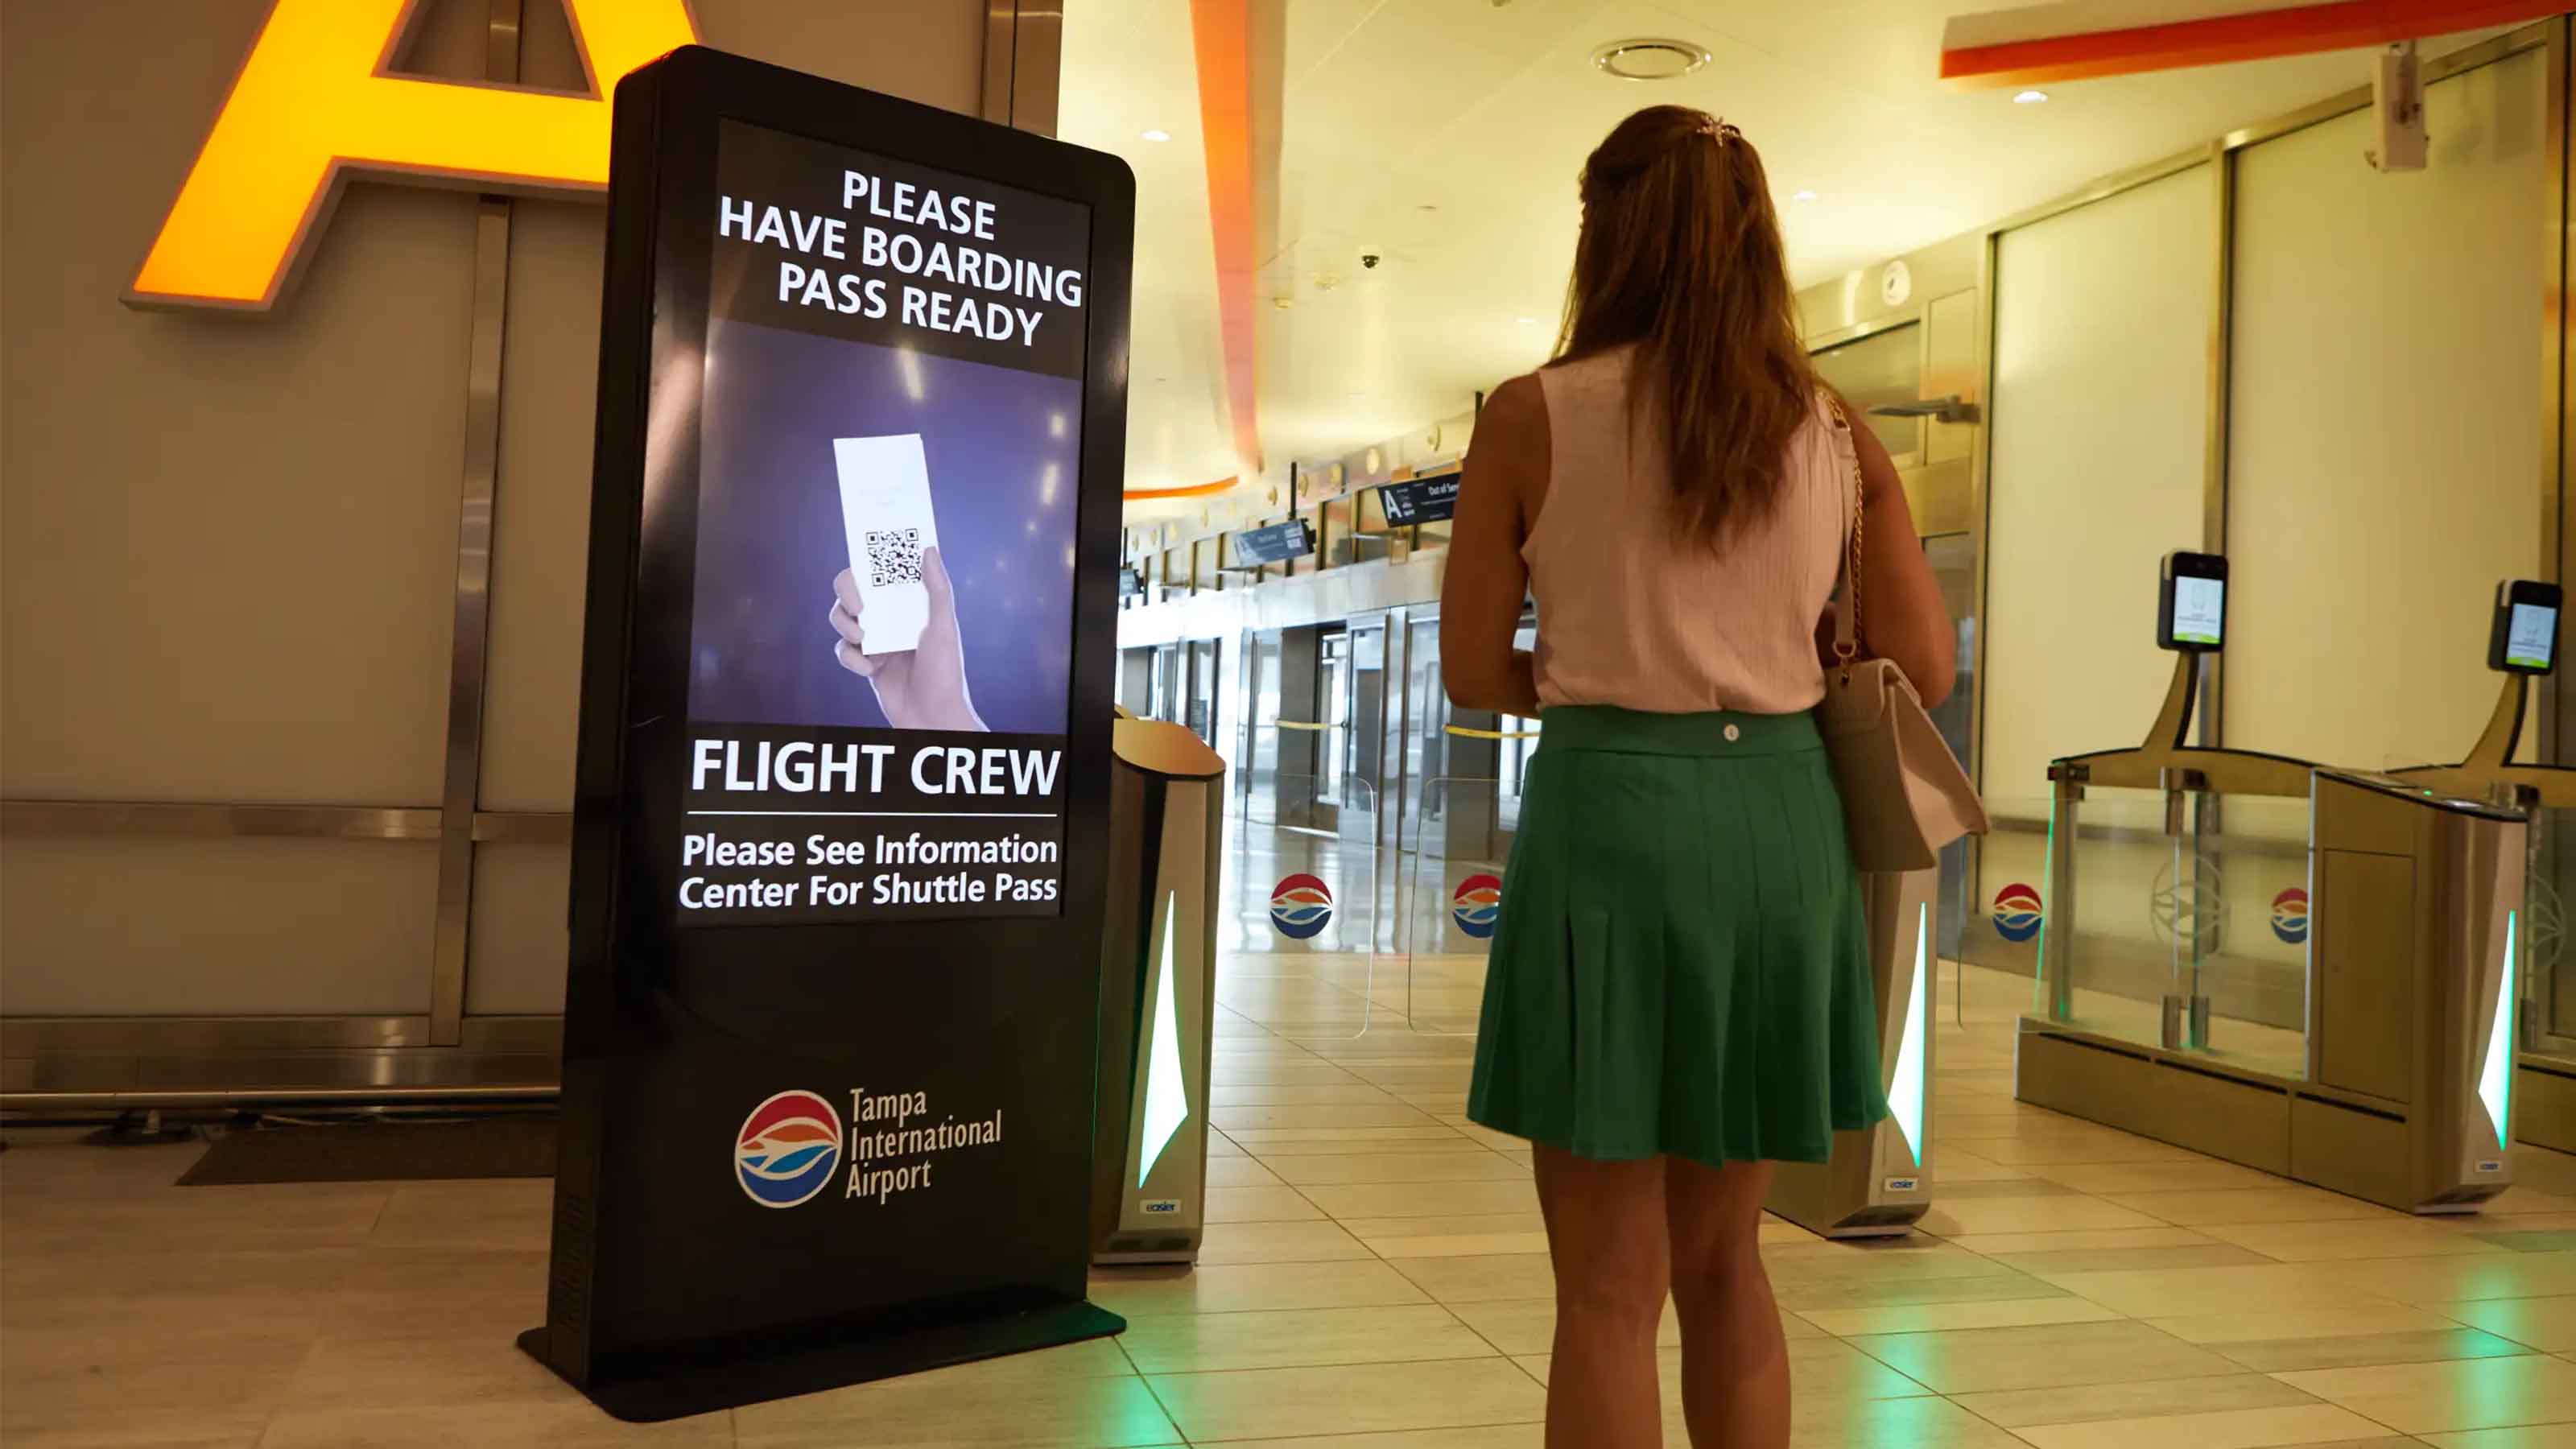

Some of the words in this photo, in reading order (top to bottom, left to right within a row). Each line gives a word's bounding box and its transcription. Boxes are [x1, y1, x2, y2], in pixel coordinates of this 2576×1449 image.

[127, 0, 698, 311] A
[843, 170, 996, 241] PLEASE
[720, 196, 847, 260] HAVE
[862, 226, 1082, 308] BOARDING
[778, 262, 887, 319] PASS
[902, 286, 1043, 347] READY
[1385, 489, 1403, 520] A
[692, 739, 895, 793] FLIGHT
[910, 745, 1062, 795] CREW
[683, 832, 795, 866] Please
[806, 834, 865, 865] See
[875, 832, 1057, 865] Information
[679, 877, 799, 909] Center
[809, 875, 864, 906] For
[873, 871, 985, 904] Shuttle
[995, 873, 1057, 902] Pass
[849, 1088, 927, 1129] Tampa
[851, 1108, 1001, 1162] International
[845, 1160, 931, 1205] Airport
